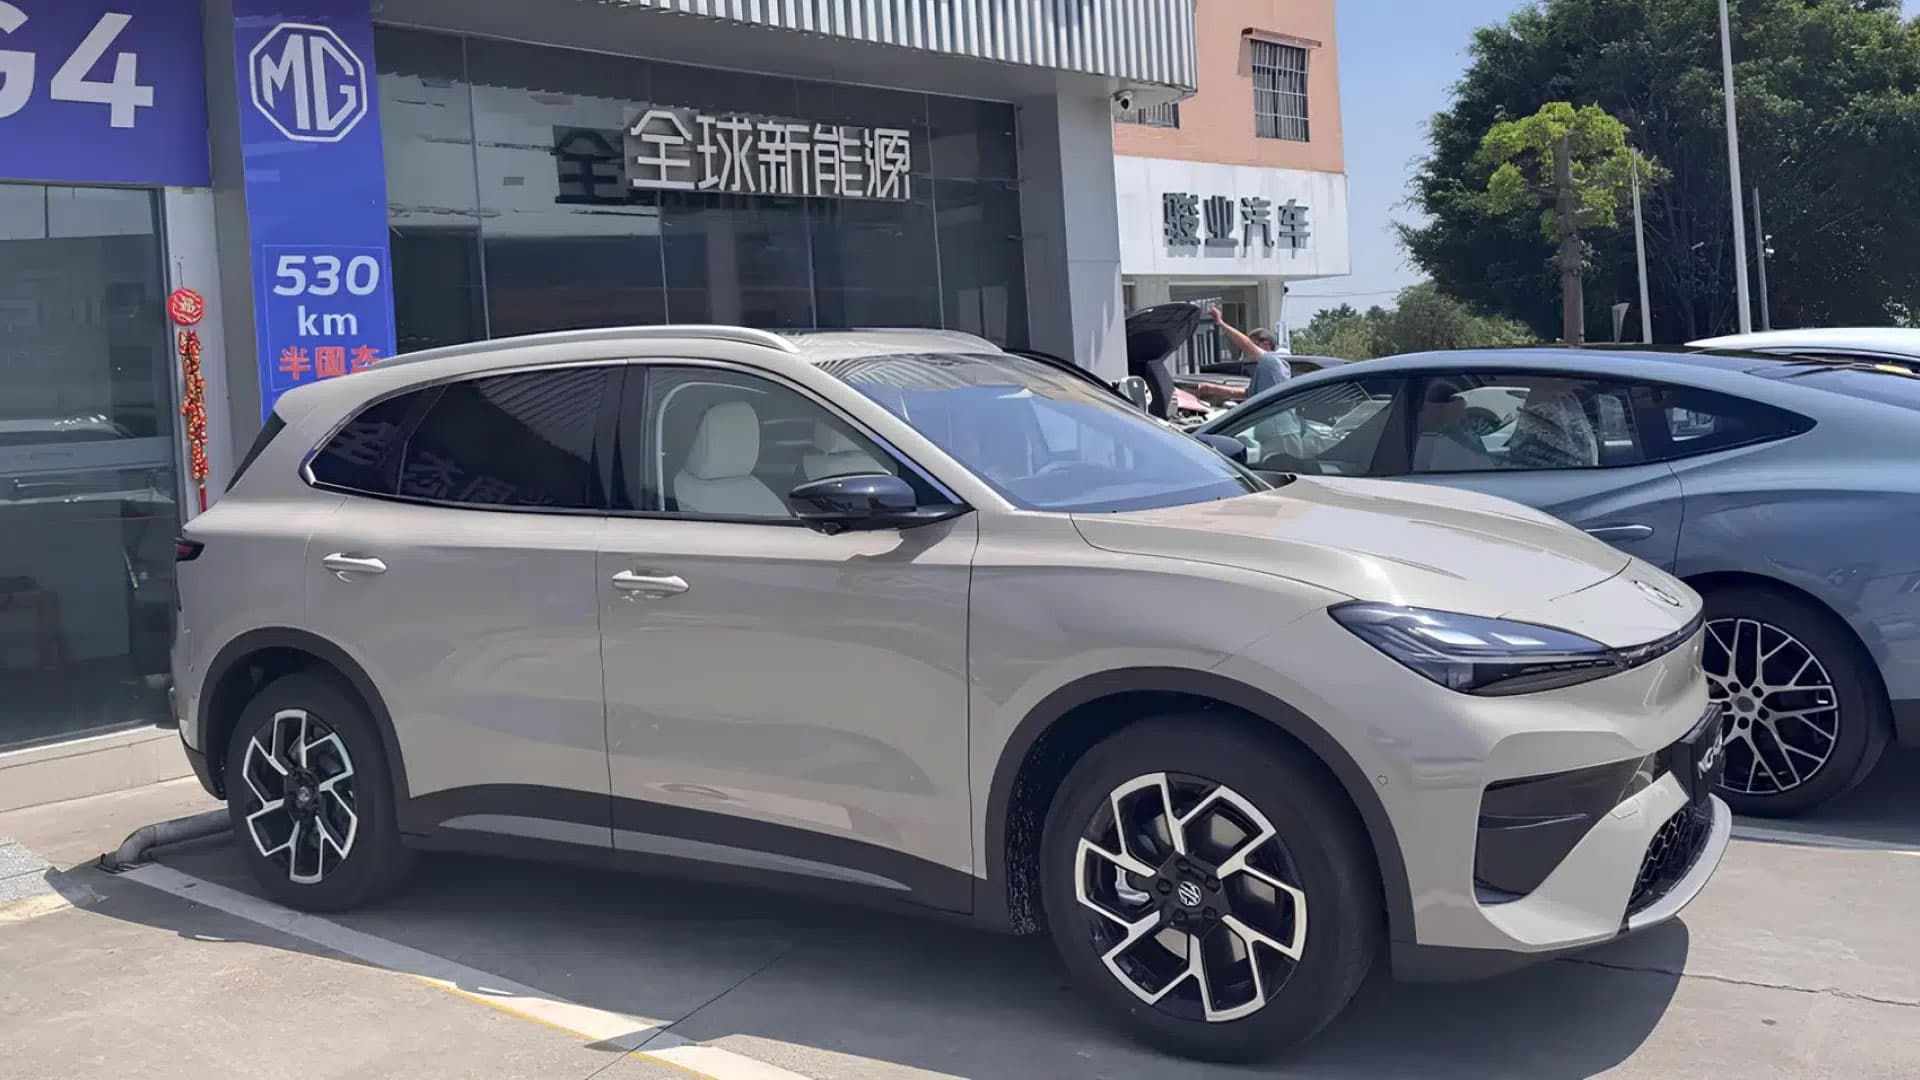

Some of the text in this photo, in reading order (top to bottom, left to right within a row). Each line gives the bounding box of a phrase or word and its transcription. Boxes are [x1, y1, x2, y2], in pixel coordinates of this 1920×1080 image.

[260, 32, 359, 131] MG
[629, 109, 911, 200] 全球新能源
[272, 255, 380, 297] 530
[298, 305, 358, 337] km
